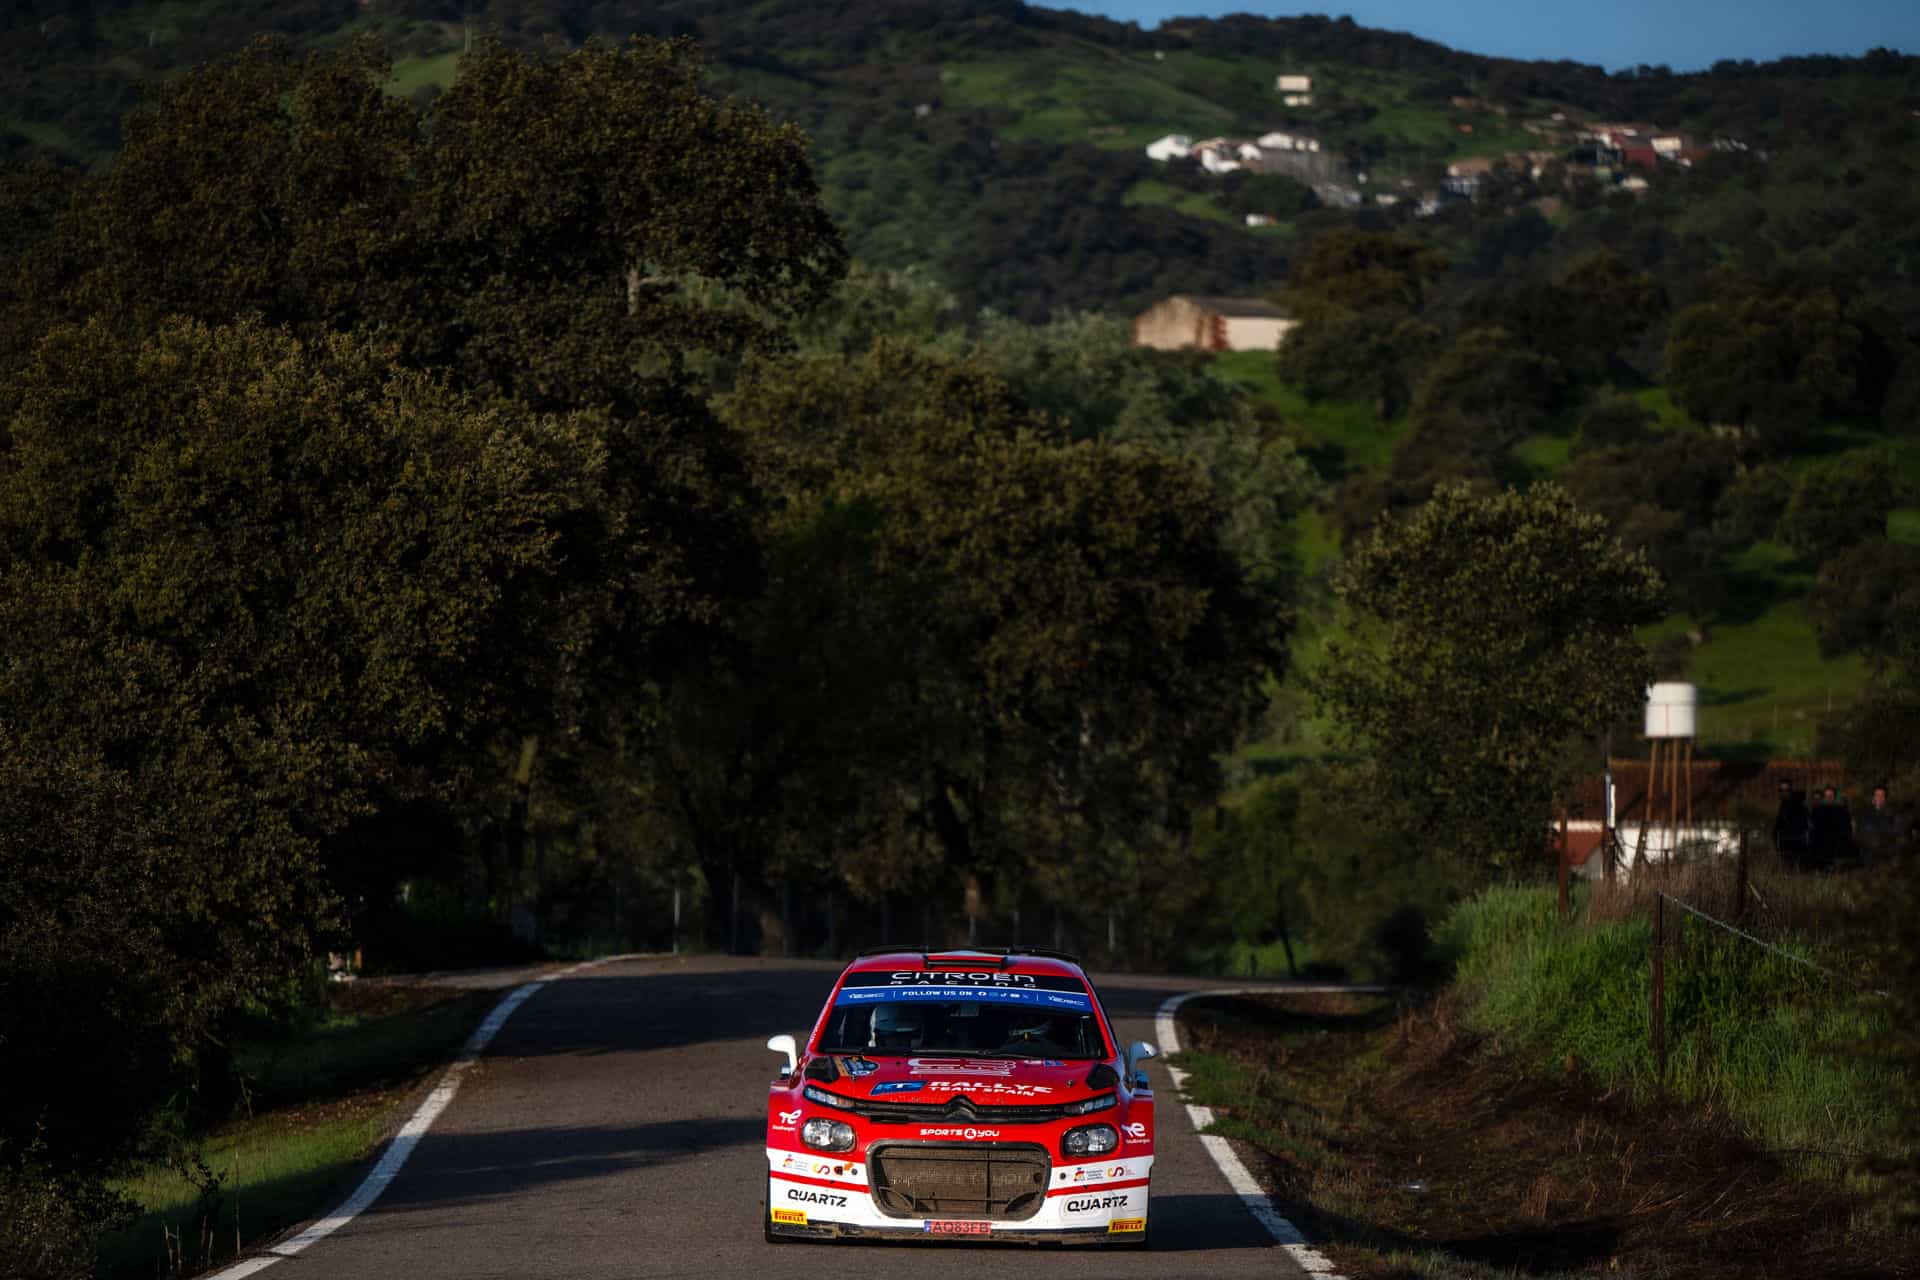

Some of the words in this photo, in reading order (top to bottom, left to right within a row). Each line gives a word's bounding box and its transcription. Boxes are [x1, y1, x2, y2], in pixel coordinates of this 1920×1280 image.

[929, 1081, 1053, 1094] RALLYE
[919, 1128, 963, 1136] SPORTS
[977, 1130, 1000, 1138] YOU
[787, 1188, 848, 1208] QUARTZ
[1067, 1195, 1129, 1212] QUARTZ
[774, 1210, 805, 1222] PIRELLI
[1111, 1220, 1143, 1231] PIRELLI
